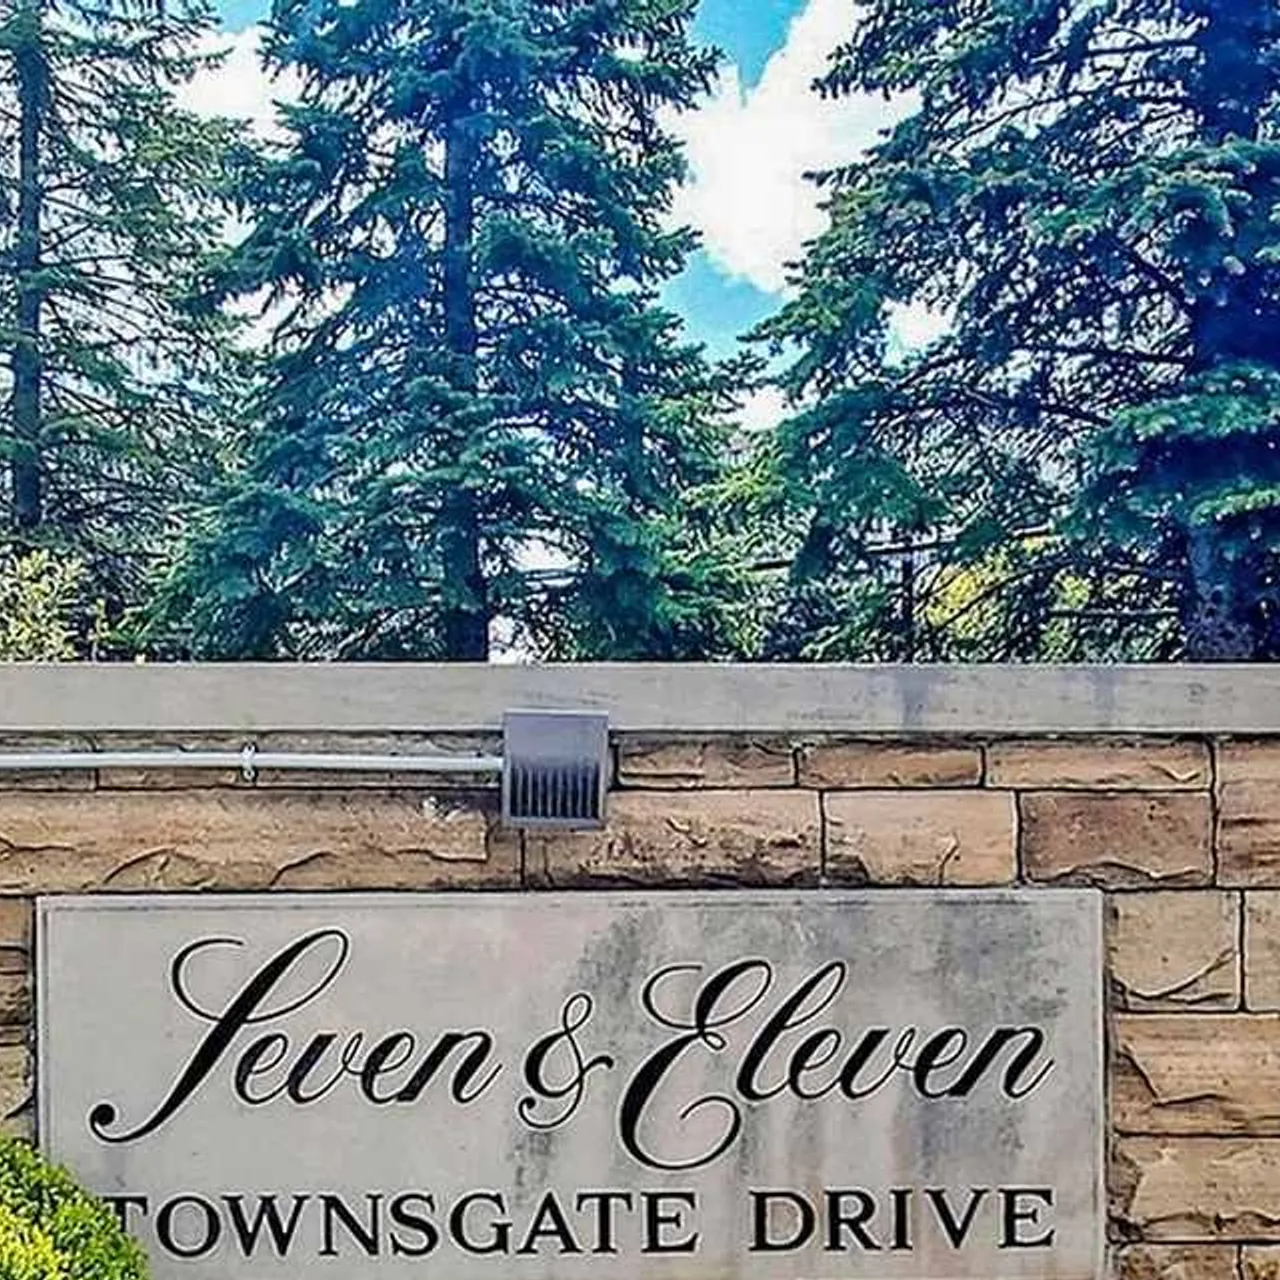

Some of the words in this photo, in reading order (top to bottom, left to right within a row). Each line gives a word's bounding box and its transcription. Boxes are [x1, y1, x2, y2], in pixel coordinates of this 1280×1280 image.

[89, 929, 503, 1144] Seven
[517, 991, 614, 1130] &
[619, 959, 1055, 1172] Eleven
[102, 1189, 699, 1258] TOWNSGATE
[747, 1187, 1056, 1253] DRIVE
